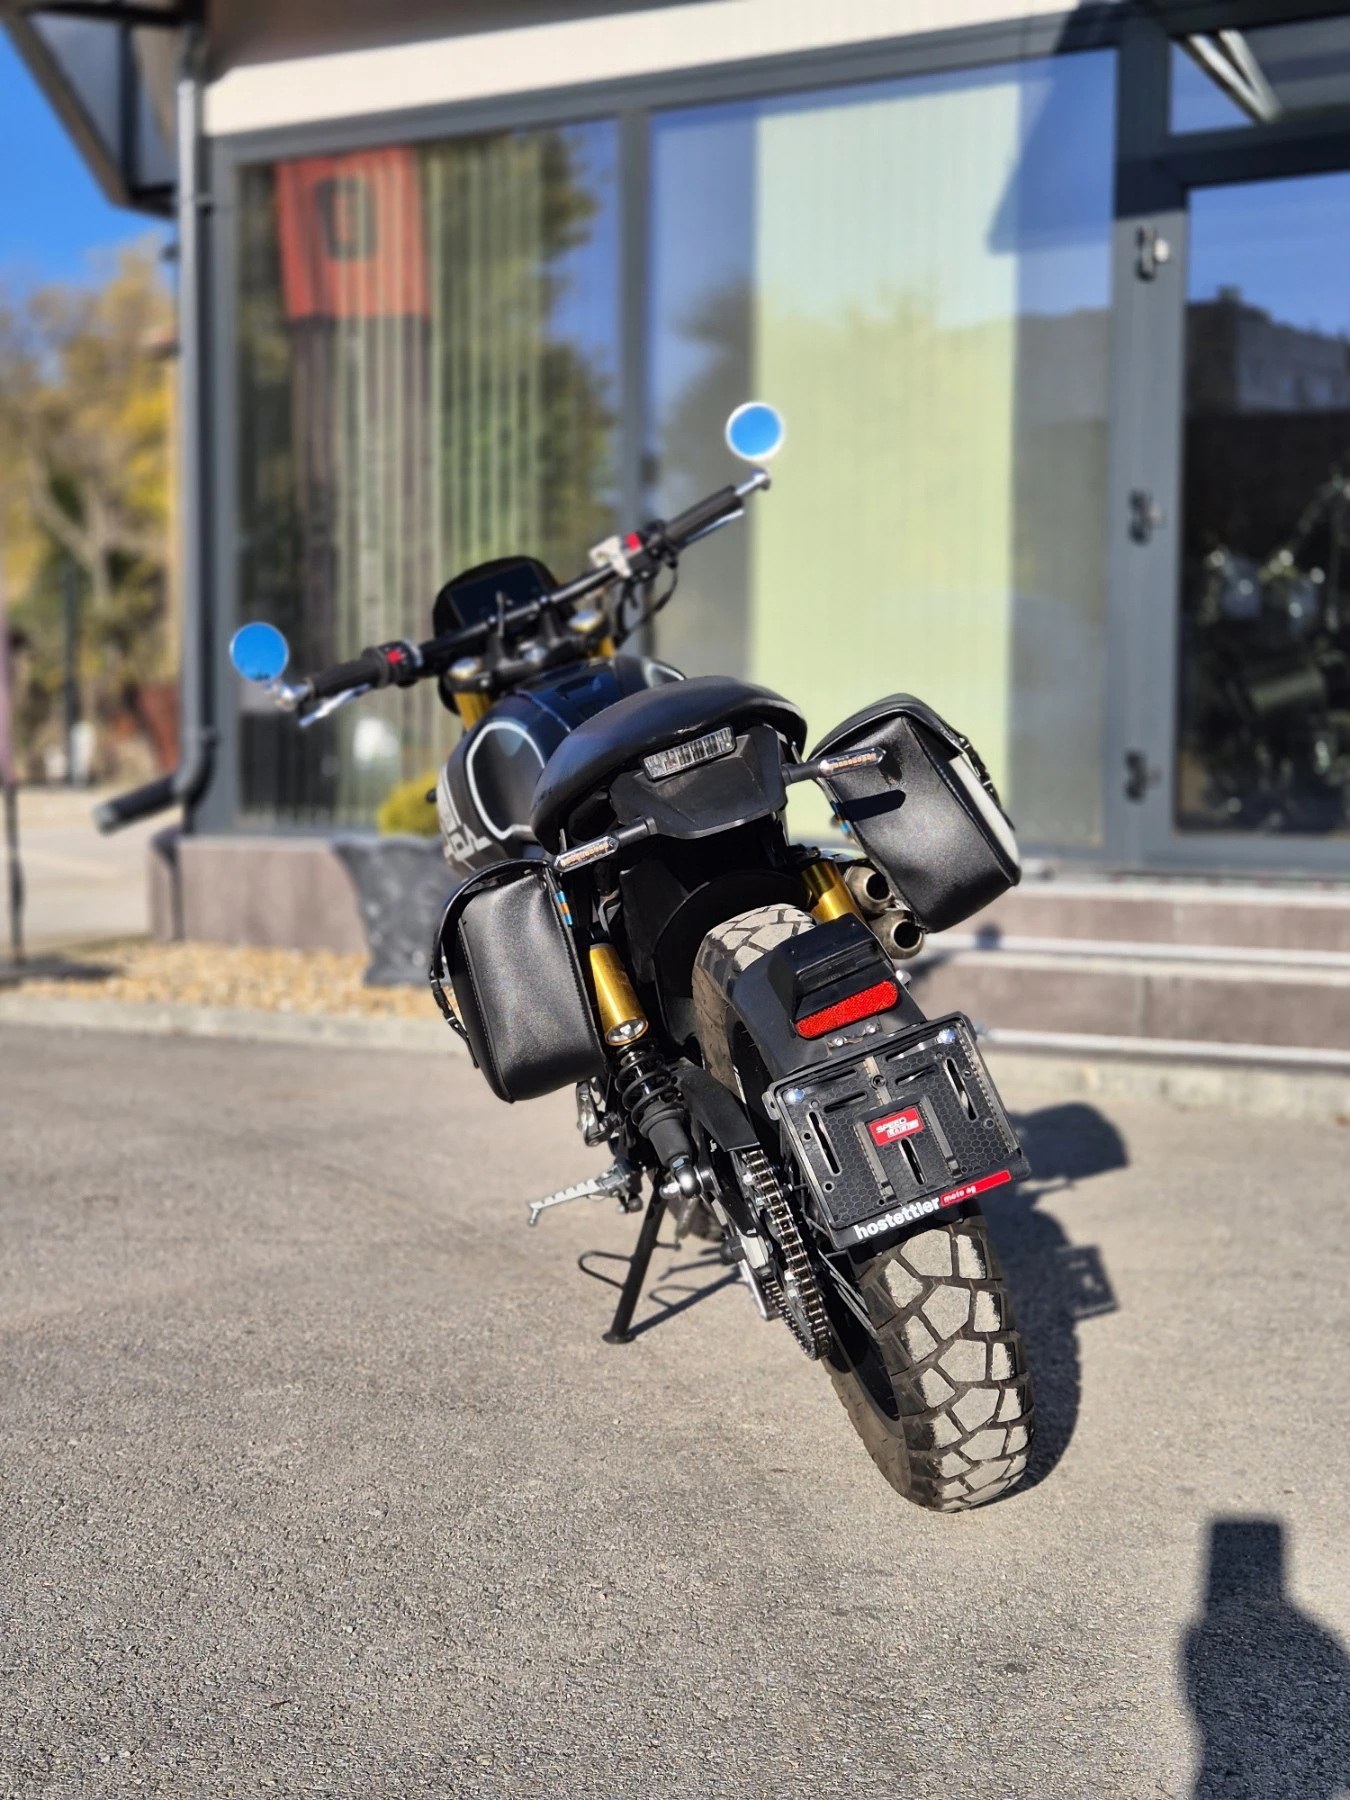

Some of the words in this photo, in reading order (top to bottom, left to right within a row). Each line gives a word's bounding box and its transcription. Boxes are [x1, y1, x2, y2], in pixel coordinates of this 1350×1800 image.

[853, 1196, 940, 1240] hostettler
[943, 1190, 965, 1203] moto
[965, 1185, 977, 1196] ag
